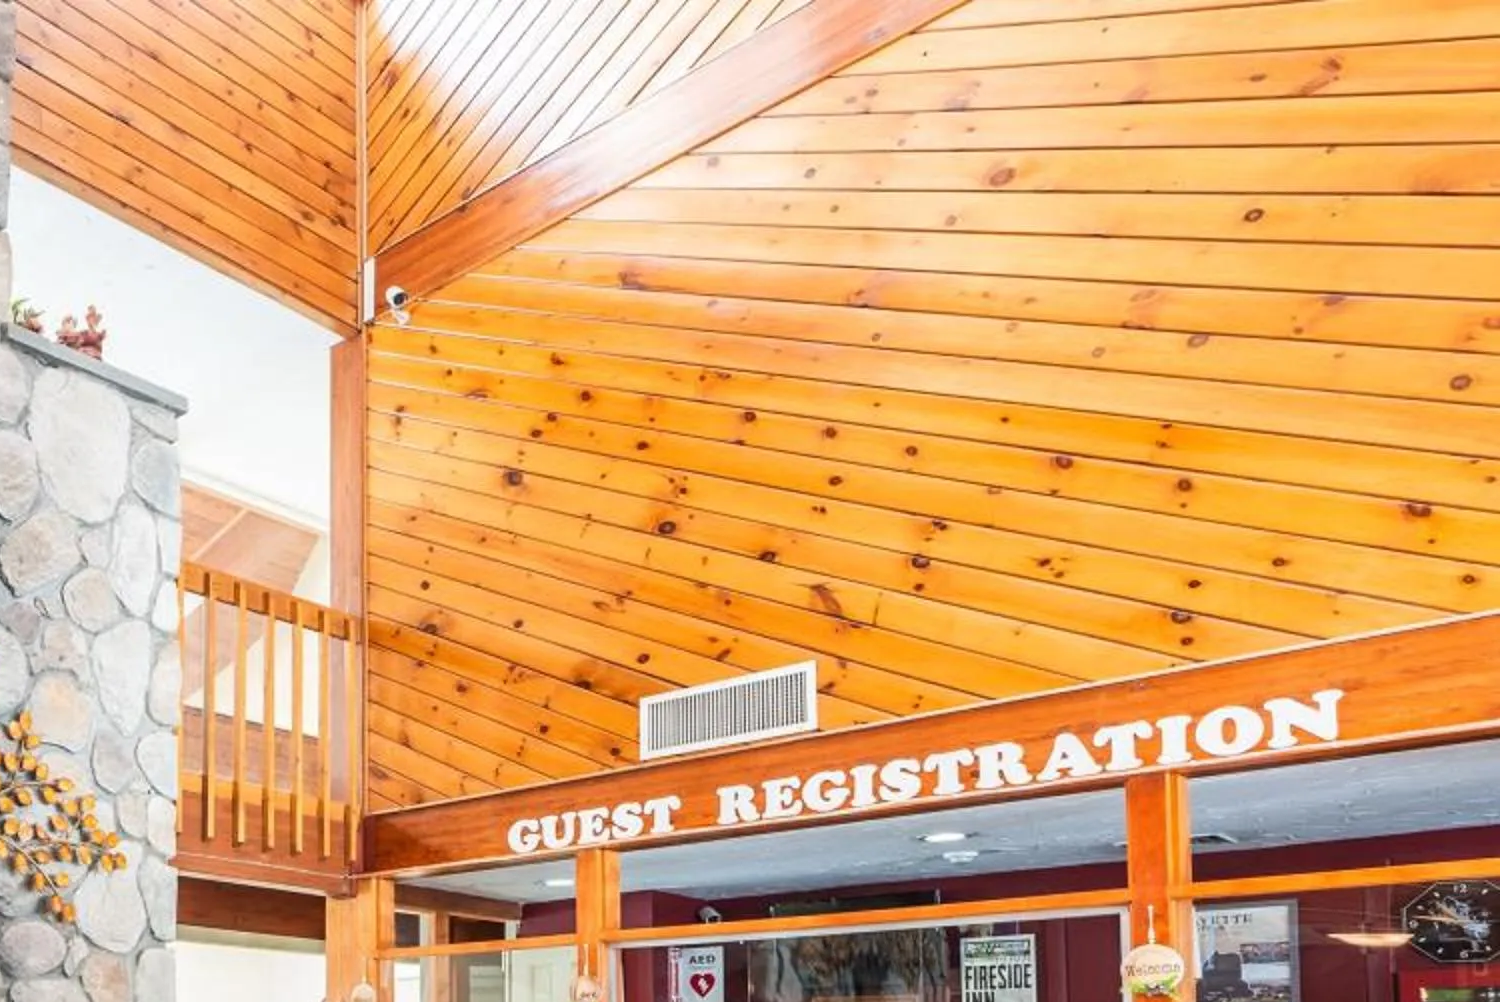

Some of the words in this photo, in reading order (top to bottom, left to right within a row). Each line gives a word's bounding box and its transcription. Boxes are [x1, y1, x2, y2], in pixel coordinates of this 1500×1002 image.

[507, 795, 682, 853] GUEST
[715, 689, 1344, 825] REGISTRATION
[688, 953, 716, 965] AED
[964, 963, 1032, 991] FIRESIDE
